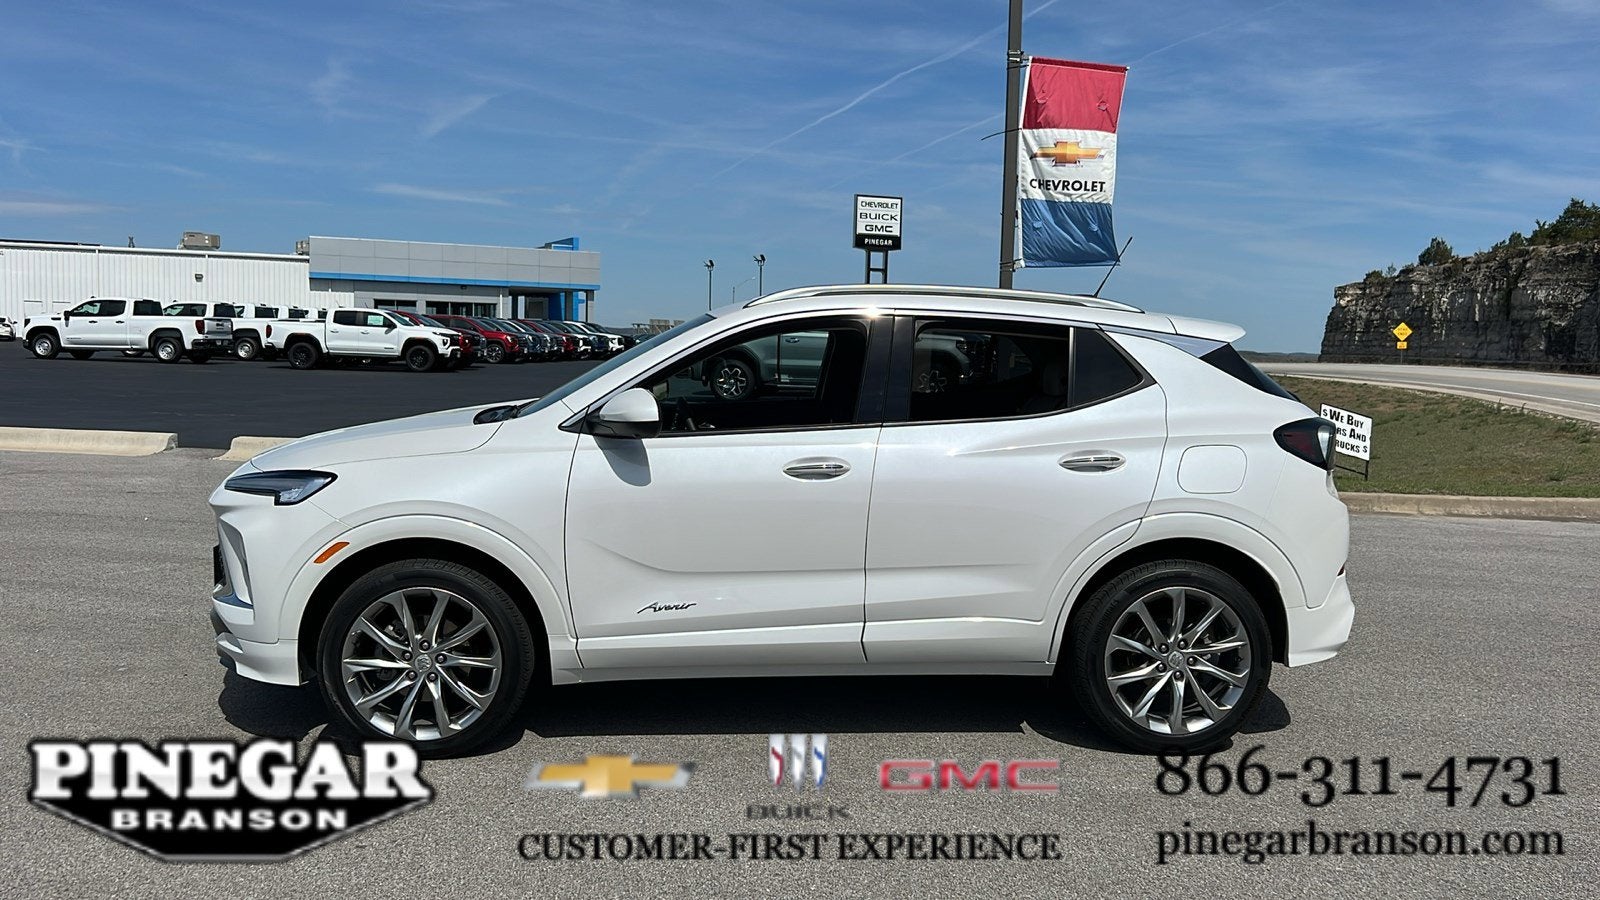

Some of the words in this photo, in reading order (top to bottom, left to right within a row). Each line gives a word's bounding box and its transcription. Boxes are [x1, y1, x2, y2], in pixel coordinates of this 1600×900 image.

[1029, 178, 1106, 193] CHEVROLET
[860, 200, 899, 209] CHEVROLET
[859, 212, 898, 222] BUICK
[864, 224, 893, 233] GMC
[864, 238, 893, 246] PINEGAR
[1336, 427, 1347, 437] RS
[1335, 439, 1360, 453] RUCKS
[637, 601, 697, 614] Avenir
